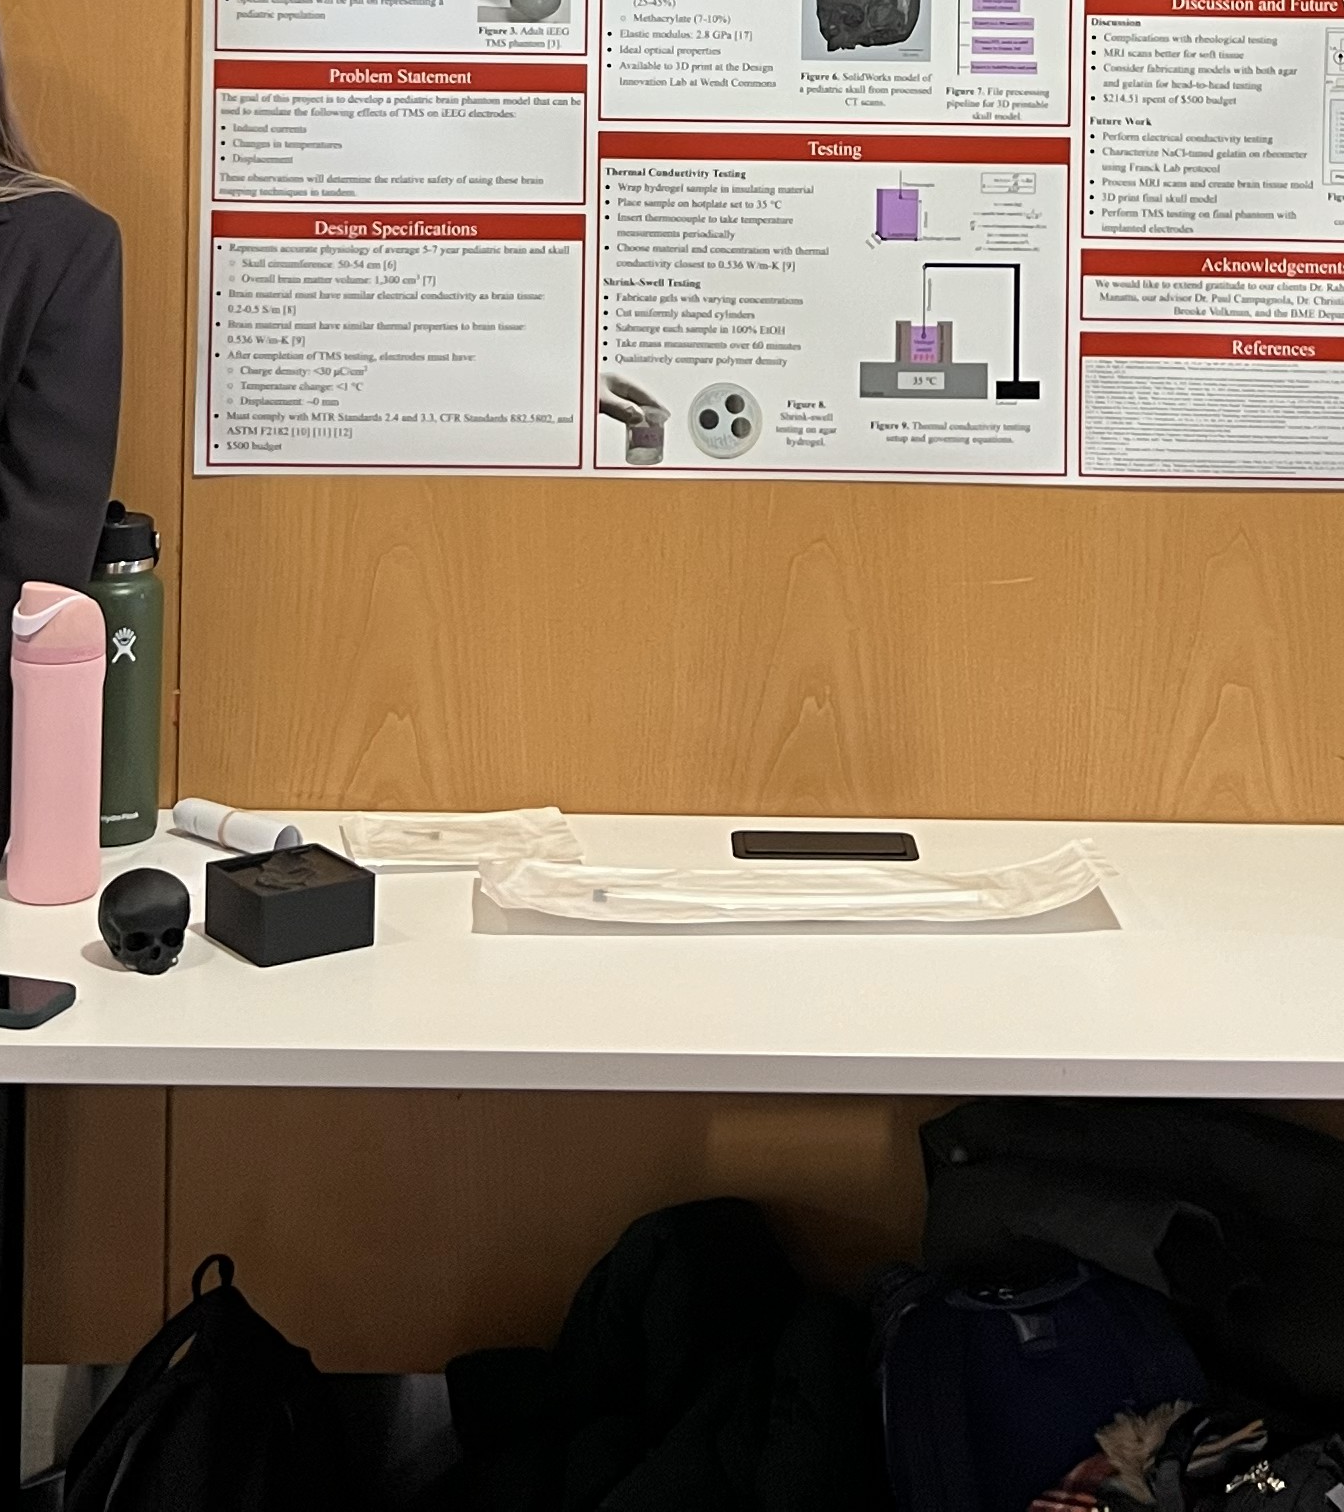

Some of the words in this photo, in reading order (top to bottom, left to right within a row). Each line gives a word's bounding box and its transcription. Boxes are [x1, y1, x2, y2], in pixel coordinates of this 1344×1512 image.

[632, 12, 692, 26] Methacrylate
[619, 28, 650, 39] Elastic
[651, 28, 693, 39] modulus:
[695, 29, 710, 40] 2.8
[711, 29, 732, 40] GPa
[733, 29, 753, 42] [17]
[619, 44, 642, 55] Ideal
[643, 44, 675, 57] optical
[676, 46, 722, 58] properties
[618, 60, 661, 71] Available
[663, 62, 674, 71] to
[675, 60, 690, 71] 3D
[690, 62, 713, 74] print
[714, 63, 724, 72] at
[725, 61, 740, 72] the
[741, 61, 774, 74] Design
[329, 67, 393, 84] Problem
[396, 68, 472, 84] Statement
[619, 76, 667, 87] Innovation
[669, 76, 687, 87] Lab
[688, 78, 698, 87] at
[699, 76, 729, 88] Wendt
[730, 77, 777, 88] Commons
[1102, 92, 1139, 103] $214.51
[1141, 95, 1166, 106] spent
[1167, 94, 1179, 104] of
[1089, 115, 1122, 126] Future
[1124, 116, 1152, 126] Work
[807, 140, 862, 160] Testing
[604, 166, 646, 177] Thermal
[647, 167, 709, 179] Conductivity
[712, 168, 746, 180] Testing
[1101, 191, 1116, 202] 3D
[1117, 193, 1140, 205] print
[1142, 192, 1163, 203] final
[1165, 192, 1188, 204] skull
[1188, 192, 1218, 204] model
[315, 220, 367, 238] Design
[372, 221, 477, 239] Specifications
[602, 276, 665, 287] Shrink-Swell
[667, 277, 701, 290] Testing
[1229, 339, 1316, 361] References
